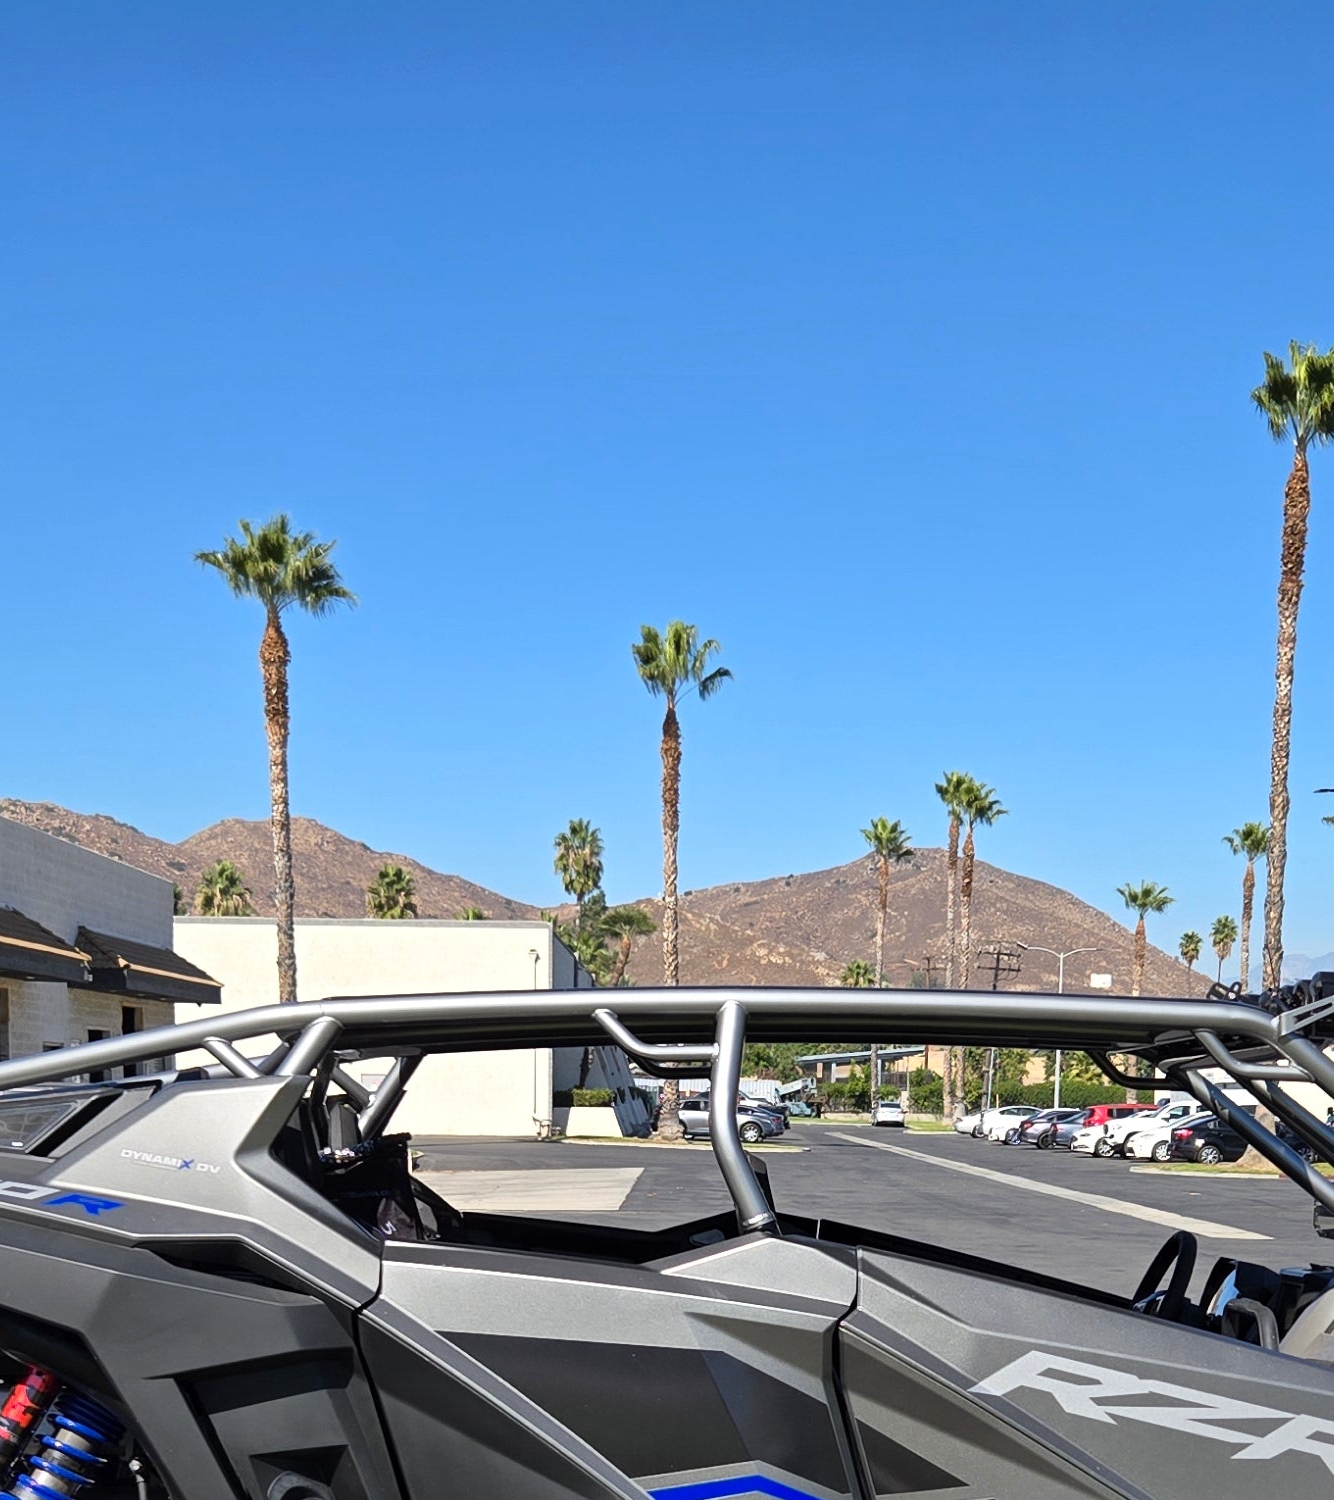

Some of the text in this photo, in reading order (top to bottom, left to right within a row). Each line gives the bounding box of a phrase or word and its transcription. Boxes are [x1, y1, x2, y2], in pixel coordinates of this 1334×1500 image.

[120, 1148, 195, 1170] DYNAMIX
[196, 1163, 221, 1174] DV
[43, 1193, 126, 1216] R
